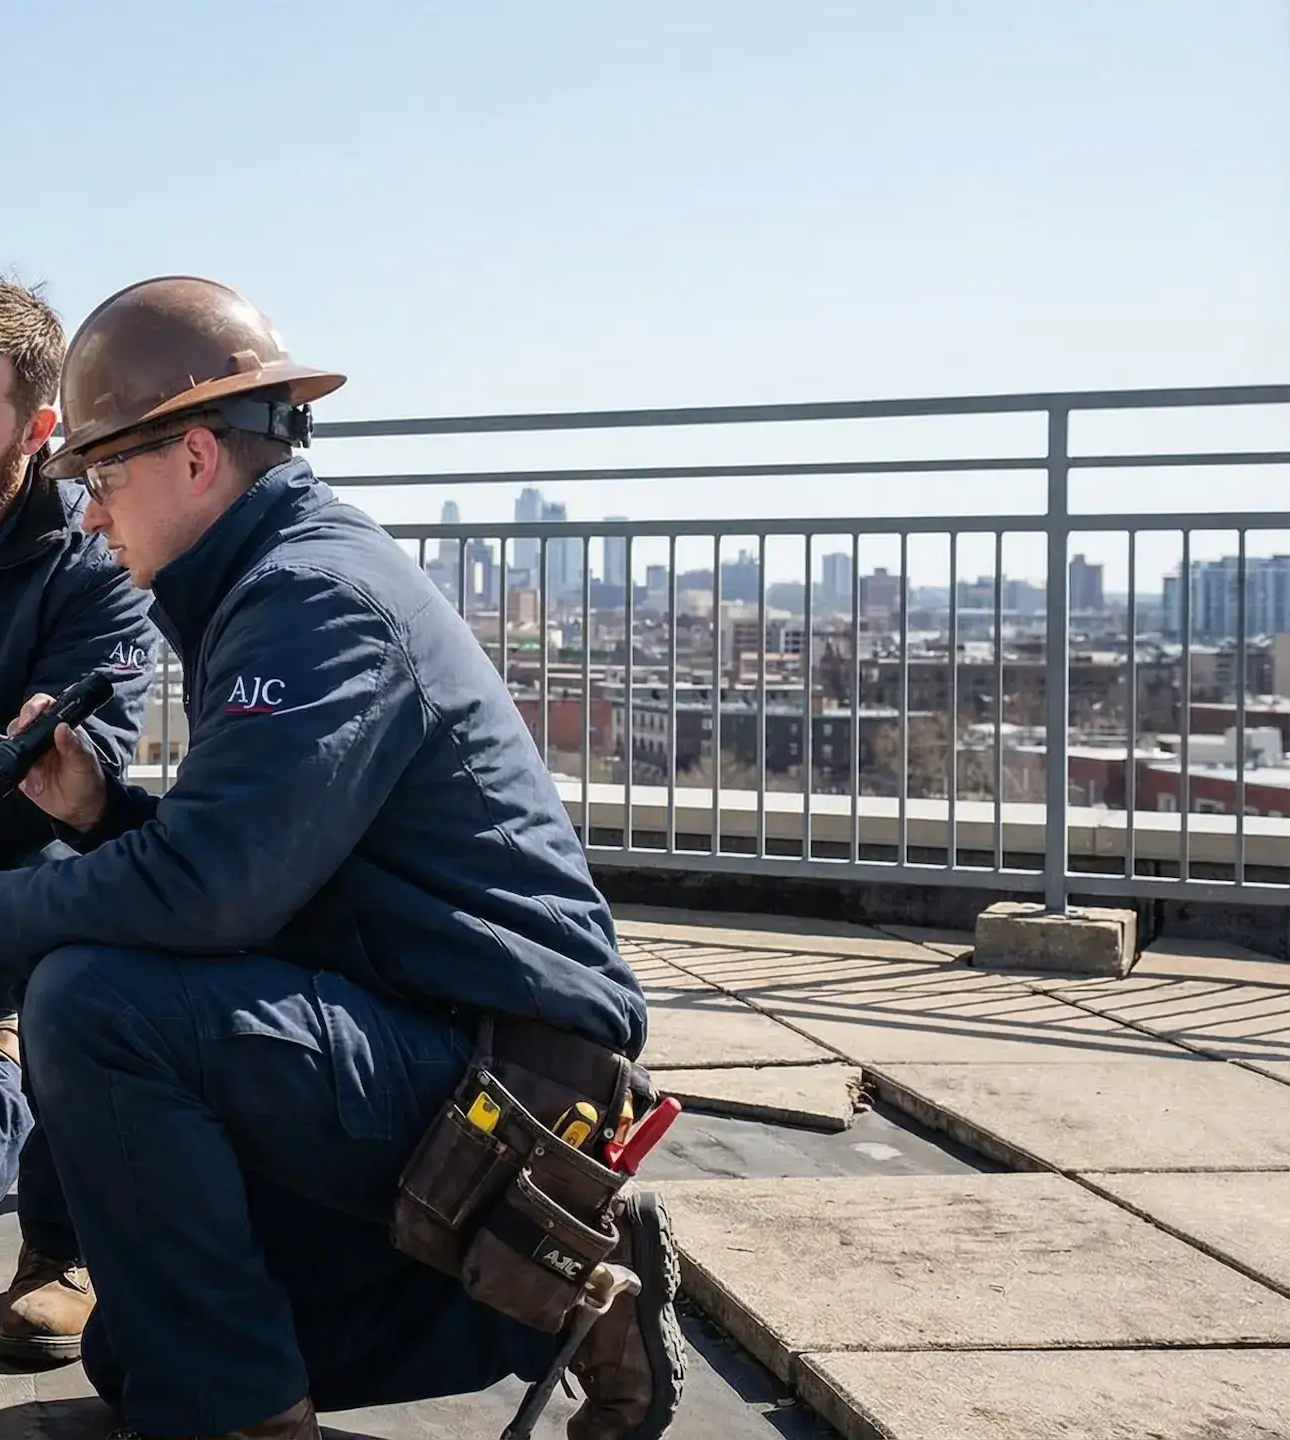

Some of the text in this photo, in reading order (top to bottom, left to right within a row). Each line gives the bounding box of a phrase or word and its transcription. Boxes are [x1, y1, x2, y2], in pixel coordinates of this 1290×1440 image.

[109, 641, 147, 669] AJC
[228, 675, 286, 709] AJC
[543, 1249, 583, 1276] AJC
